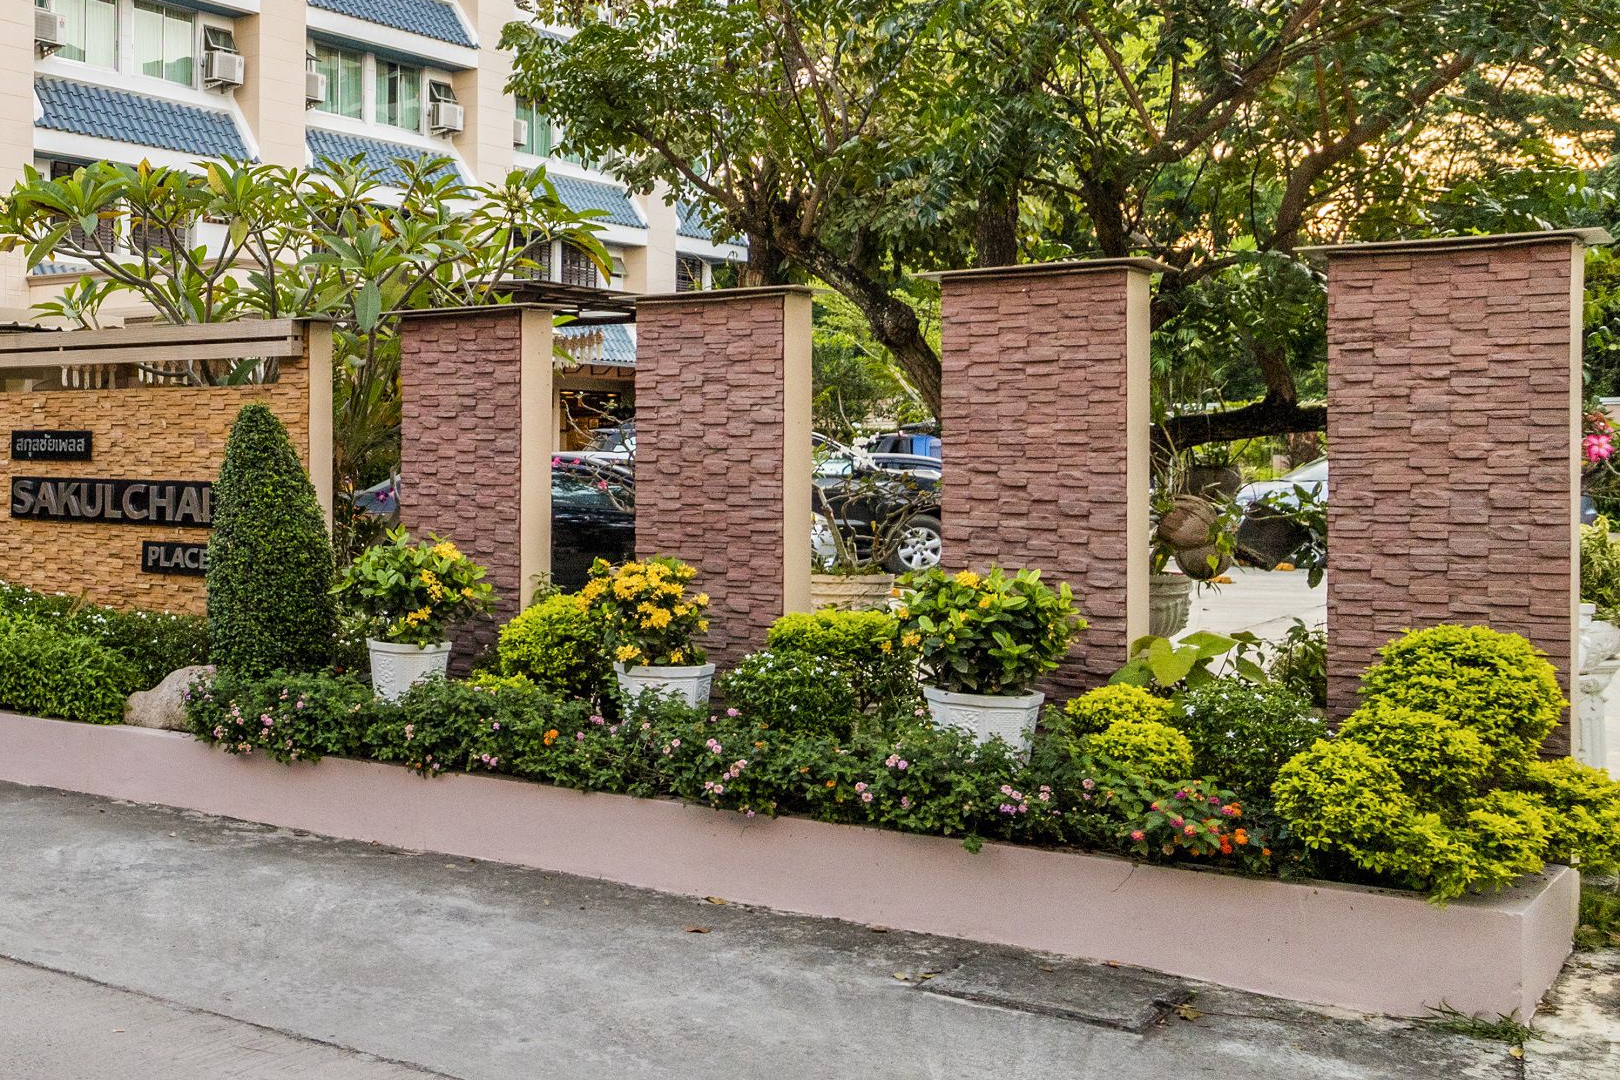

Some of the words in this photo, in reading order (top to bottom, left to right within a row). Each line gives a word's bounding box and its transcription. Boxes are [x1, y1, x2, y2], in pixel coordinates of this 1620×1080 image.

[15, 433, 86, 458] สกุลชัยเพลส
[12, 480, 211, 523] SAKULCHAI
[147, 546, 210, 570] PLACE
